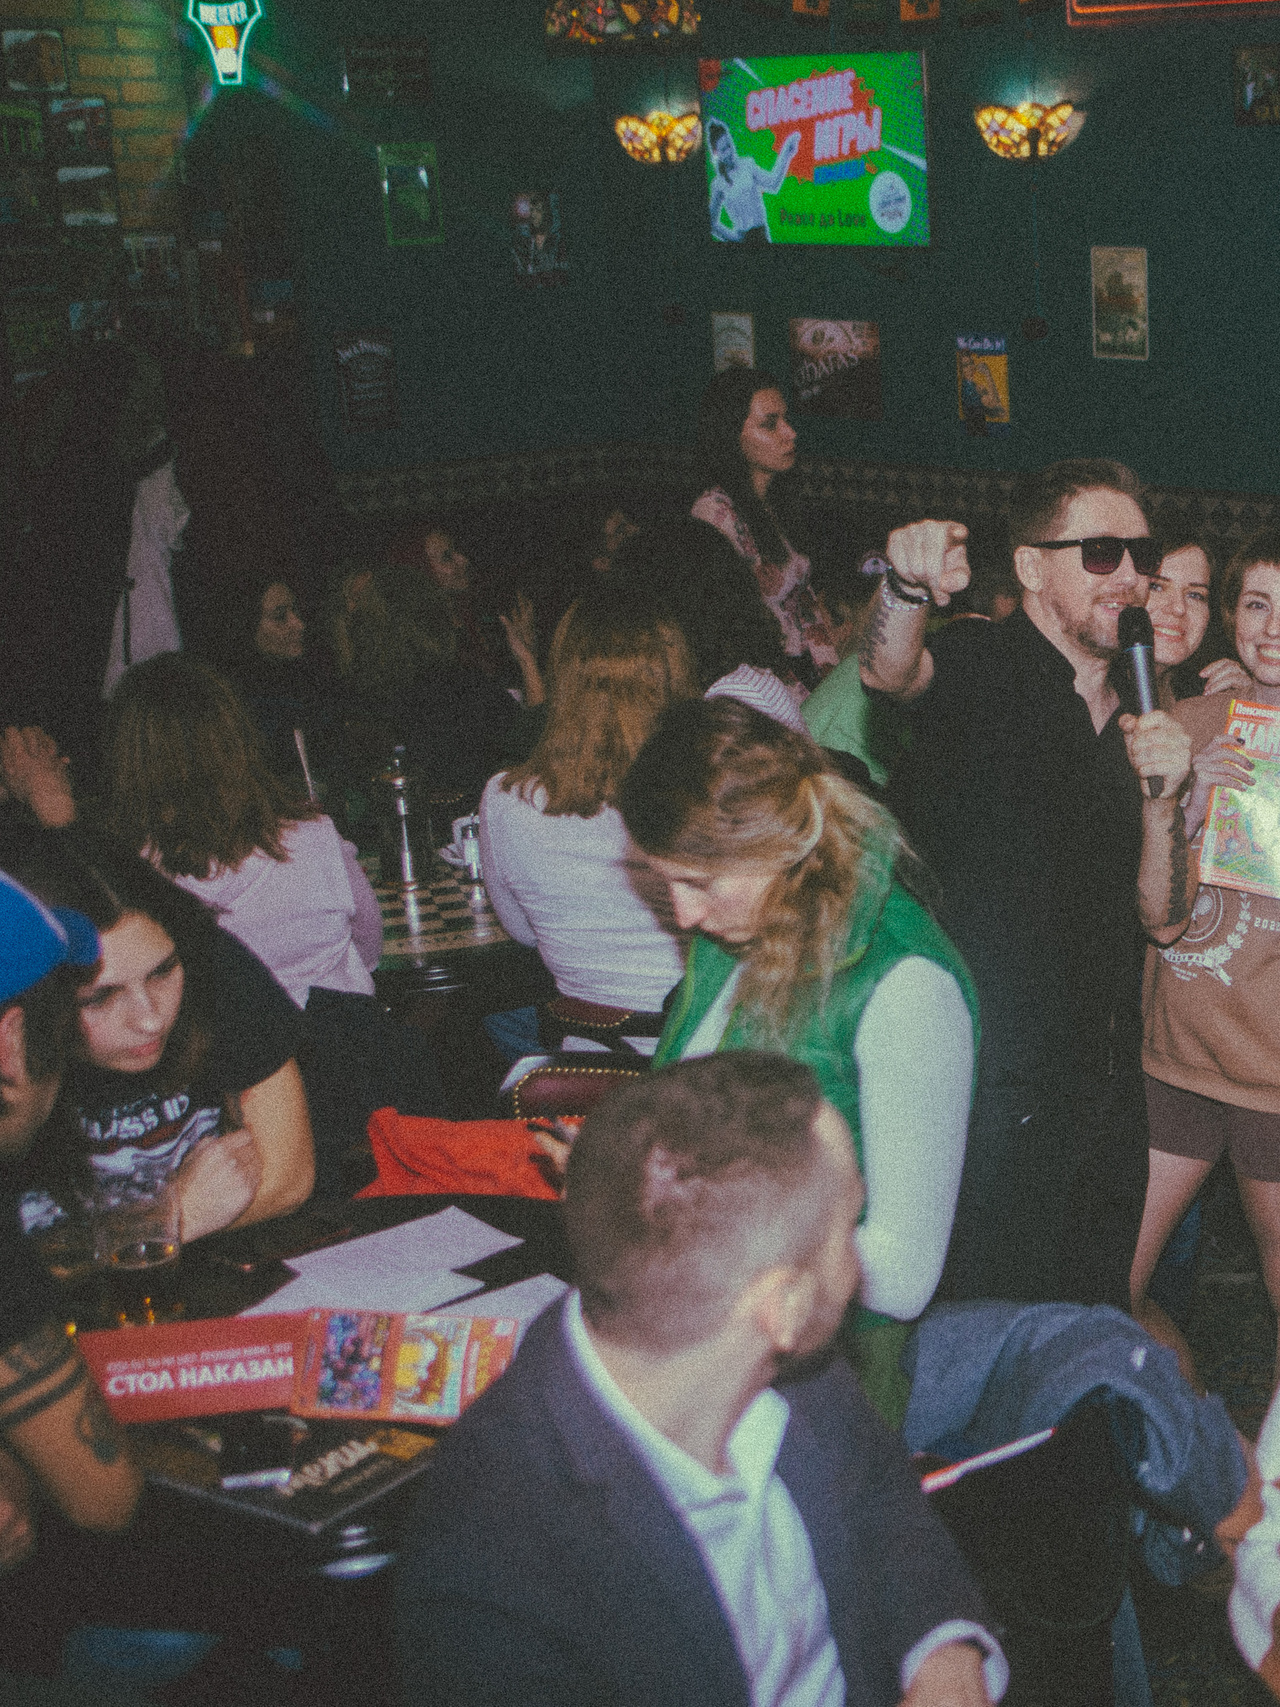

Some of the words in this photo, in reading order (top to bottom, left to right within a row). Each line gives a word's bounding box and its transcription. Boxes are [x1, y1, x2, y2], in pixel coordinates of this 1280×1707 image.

[746, 69, 854, 131] СПАСЕНИЕ
[813, 107, 882, 161] ИГРЫ
[106, 1370, 175, 1397] СТОЛ
[178, 1356, 294, 1389] НАКАЗАН
